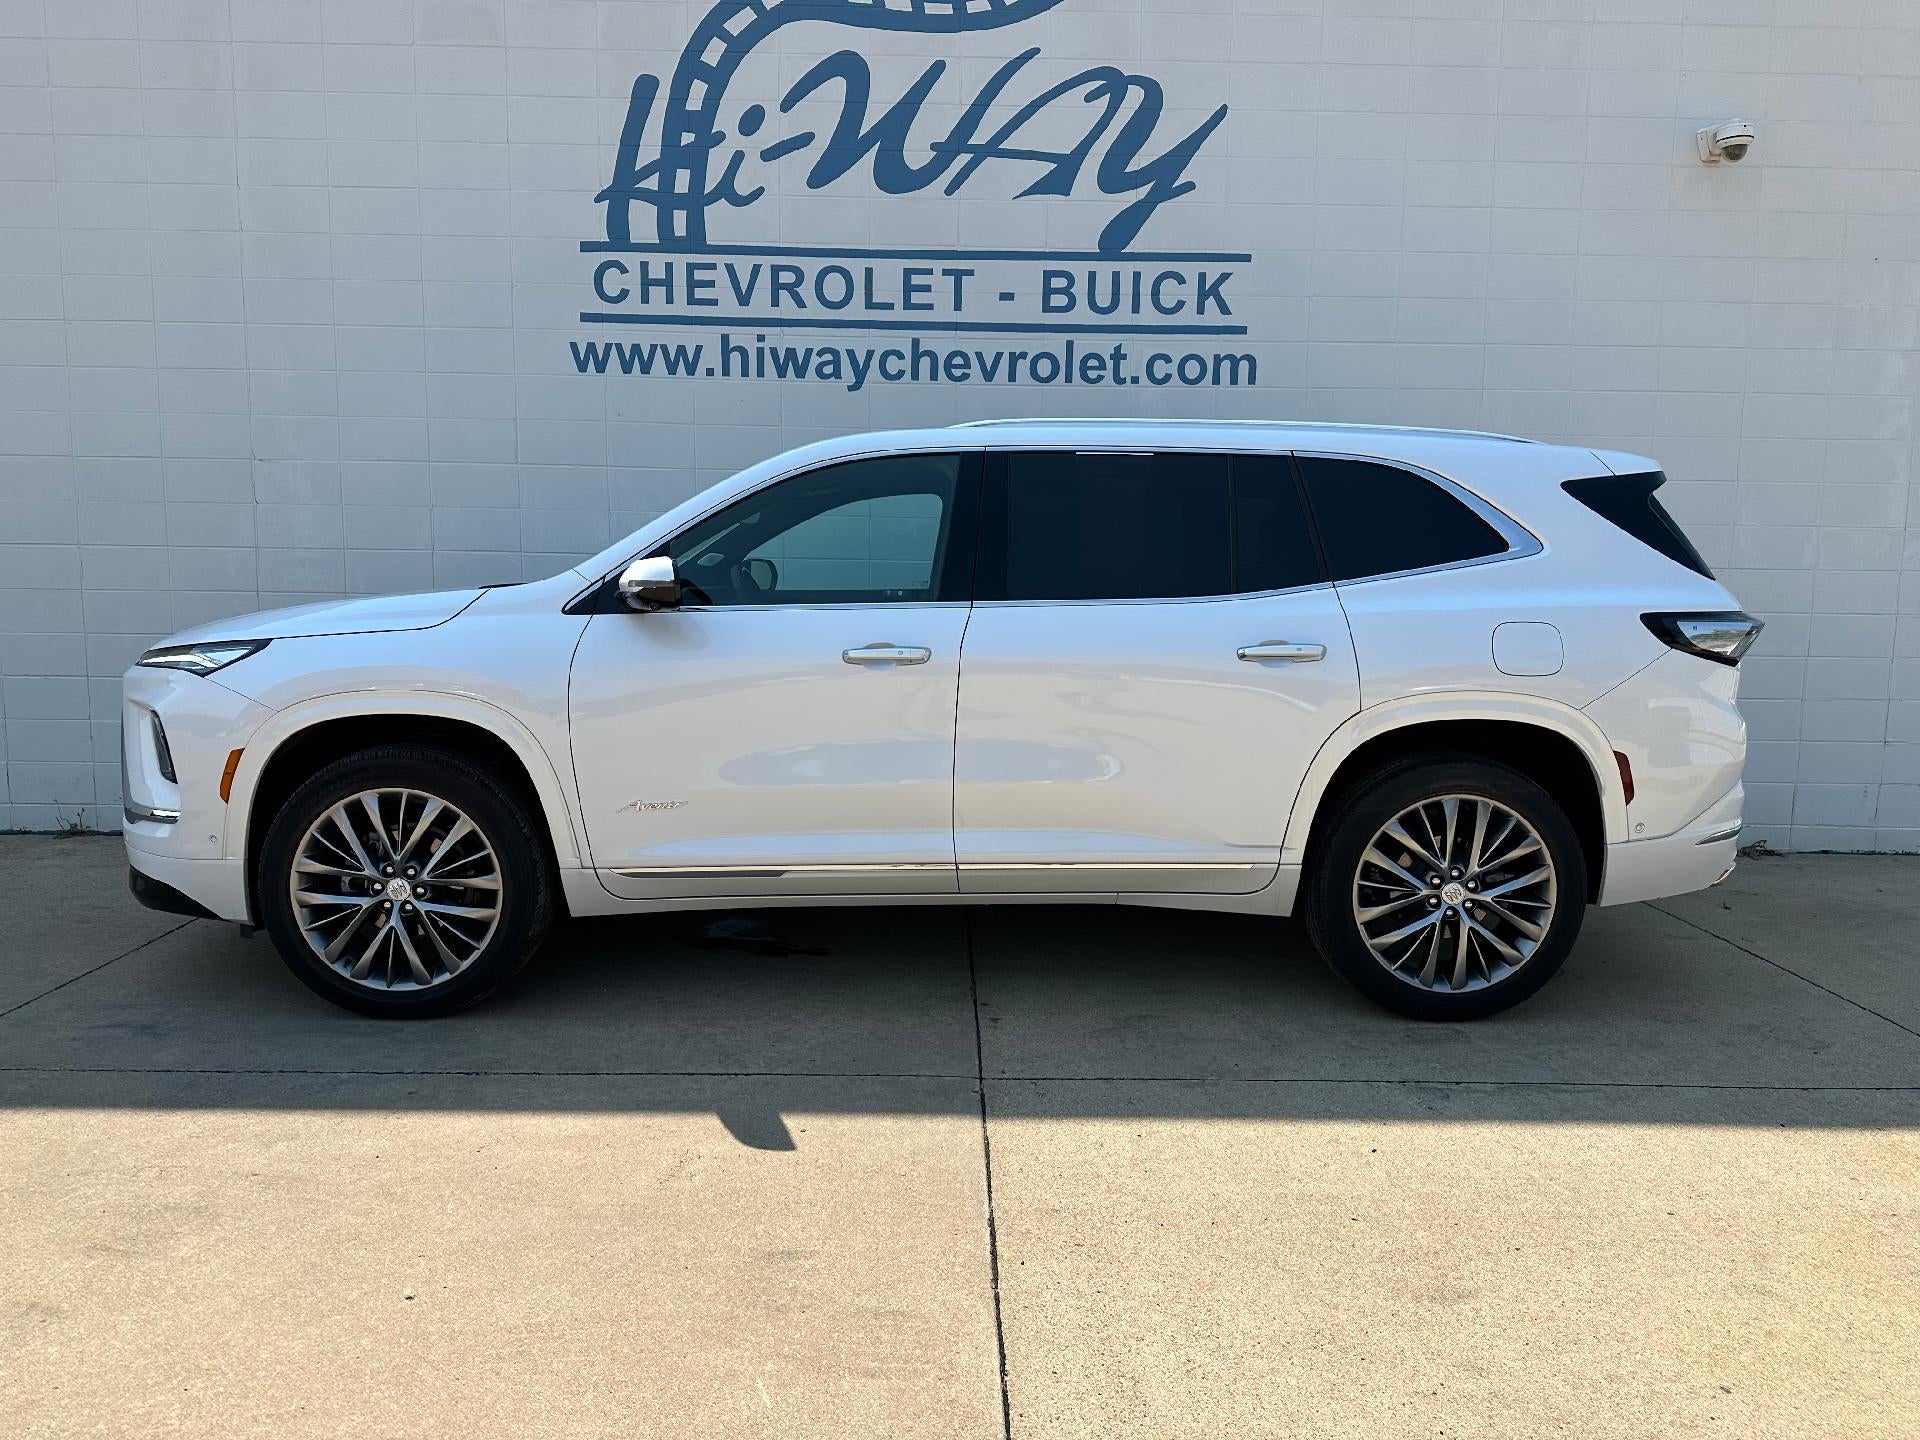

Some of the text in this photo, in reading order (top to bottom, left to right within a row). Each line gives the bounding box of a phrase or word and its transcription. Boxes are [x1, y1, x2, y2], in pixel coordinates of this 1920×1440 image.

[594, 259, 975, 312] CHEVROLET
[1041, 269, 1234, 316] BUICK
[569, 333, 1257, 392] www.hiwaychevrolet.com
[616, 799, 688, 813] Avenir
